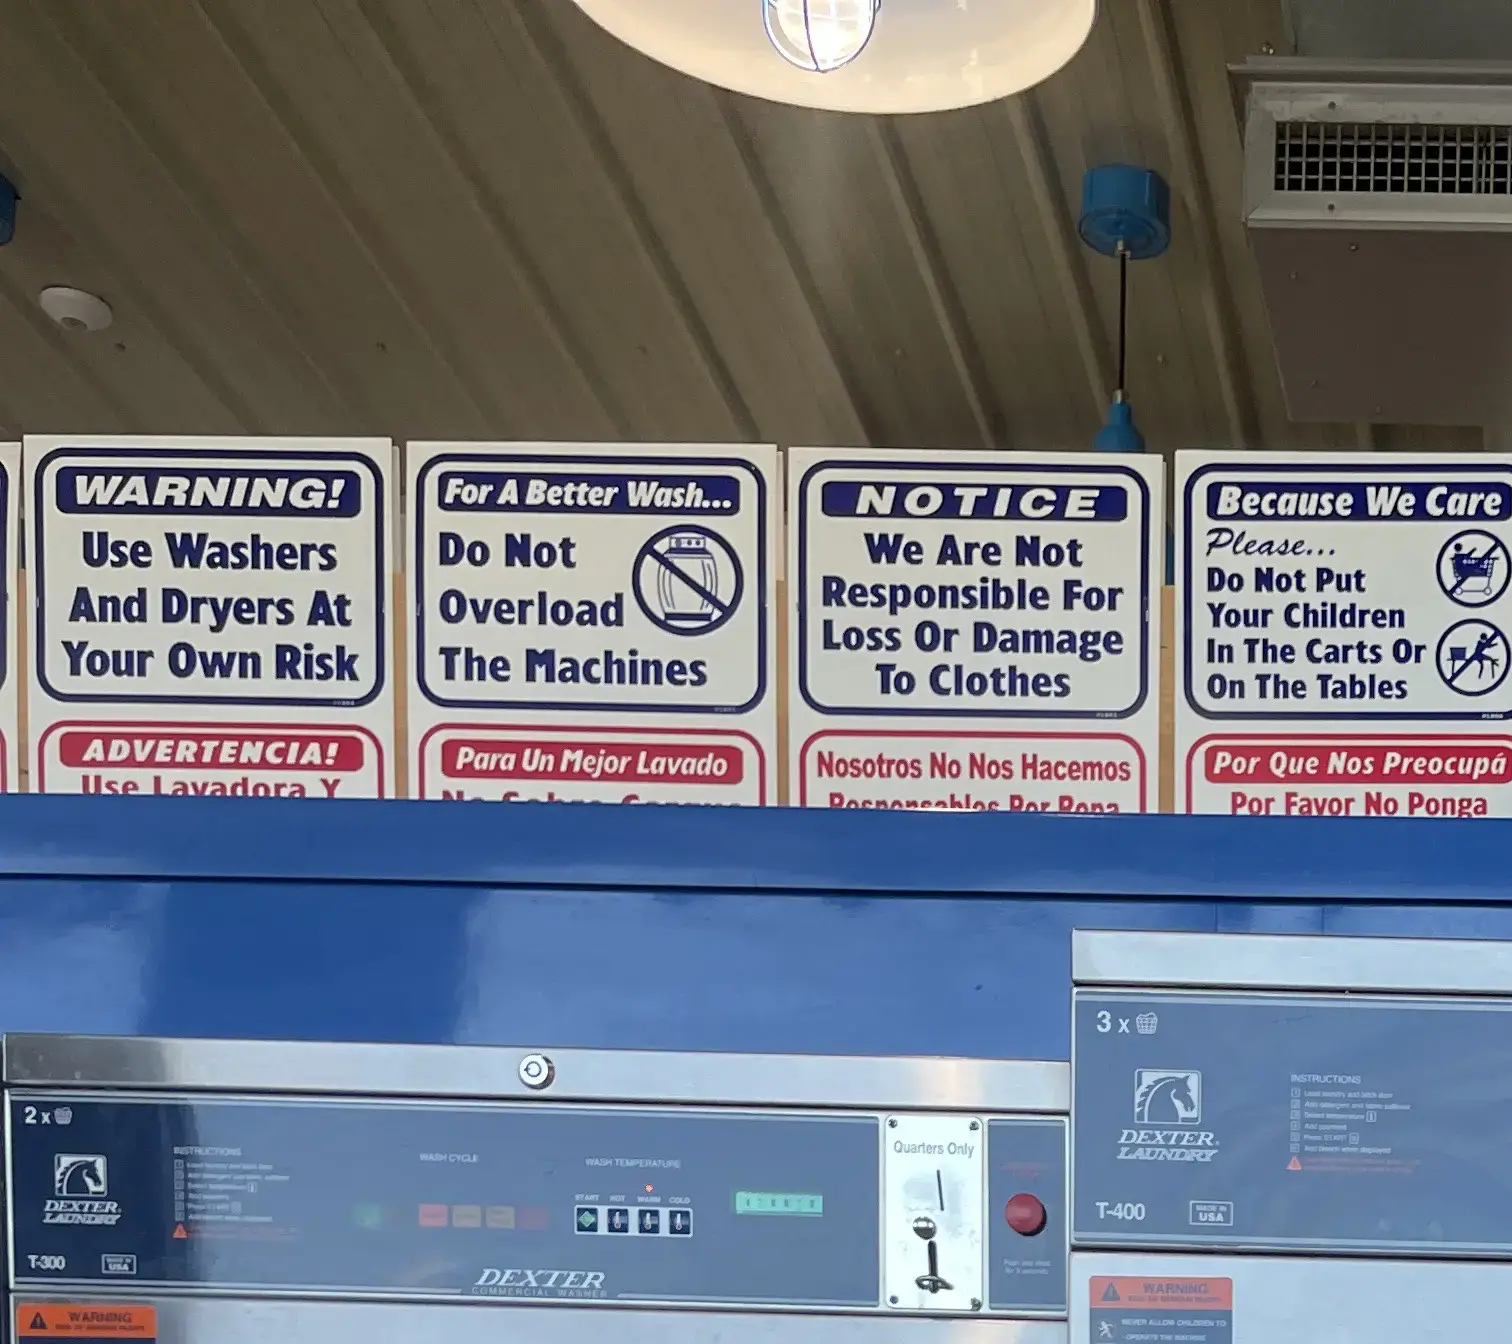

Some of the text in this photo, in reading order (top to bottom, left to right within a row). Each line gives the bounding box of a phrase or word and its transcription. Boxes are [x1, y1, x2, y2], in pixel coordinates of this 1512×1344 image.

[75, 475, 345, 509] WARNING!
[444, 478, 732, 508] For A Better Wash...
[855, 485, 1100, 518] NOTICE
[1217, 485, 1502, 517] Because We Care
[82, 531, 338, 571] Use Washers
[439, 532, 577, 568] Do Not
[864, 533, 1083, 567] We Are Not
[1206, 527, 1336, 557] Please...
[1207, 567, 1366, 592] Do Not Put
[439, 589, 624, 626] Overload
[822, 575, 1124, 615] Responsible For
[68, 587, 352, 633] And Dryers At
[1207, 601, 1406, 628] Your Children
[822, 619, 1123, 662] Loss Or Damage
[1207, 638, 1427, 664] In The Carts Or
[61, 641, 360, 681] Your Own Risk
[439, 646, 707, 686] The Machines
[875, 663, 1071, 697] To Clothes
[1207, 674, 1408, 699] On The Tables
[82, 739, 340, 766] ADVERTENCIA!
[456, 747, 728, 778] Para Un Mejor Lavado
[817, 751, 1131, 781] Nosotros No Nos Hacemos
[1213, 751, 1260, 775] Por
[1269, 752, 1318, 775] Que
[1327, 752, 1374, 775] Nos
[81, 775, 139, 796] Use
[320, 778, 341, 799] Y
[1231, 792, 1488, 818] Por Favor No Ponga
[1097, 1011, 1129, 1033] 3 x
[1291, 1074, 1361, 1084] INSTRUCTIONS
[24, 1107, 37, 1124] 2
[894, 1141, 974, 1158] Quarters Only
[1118, 1130, 1216, 1146] DEXTER
[1117, 1147, 1218, 1162] LAUNDRY
[1096, 1202, 1146, 1221] T-400
[1199, 1212, 1224, 1222] USA
[28, 1255, 66, 1270] T-300
[474, 1268, 606, 1289] DEXTER
[472, 1287, 607, 1298] COMMERCIAL WASHER
